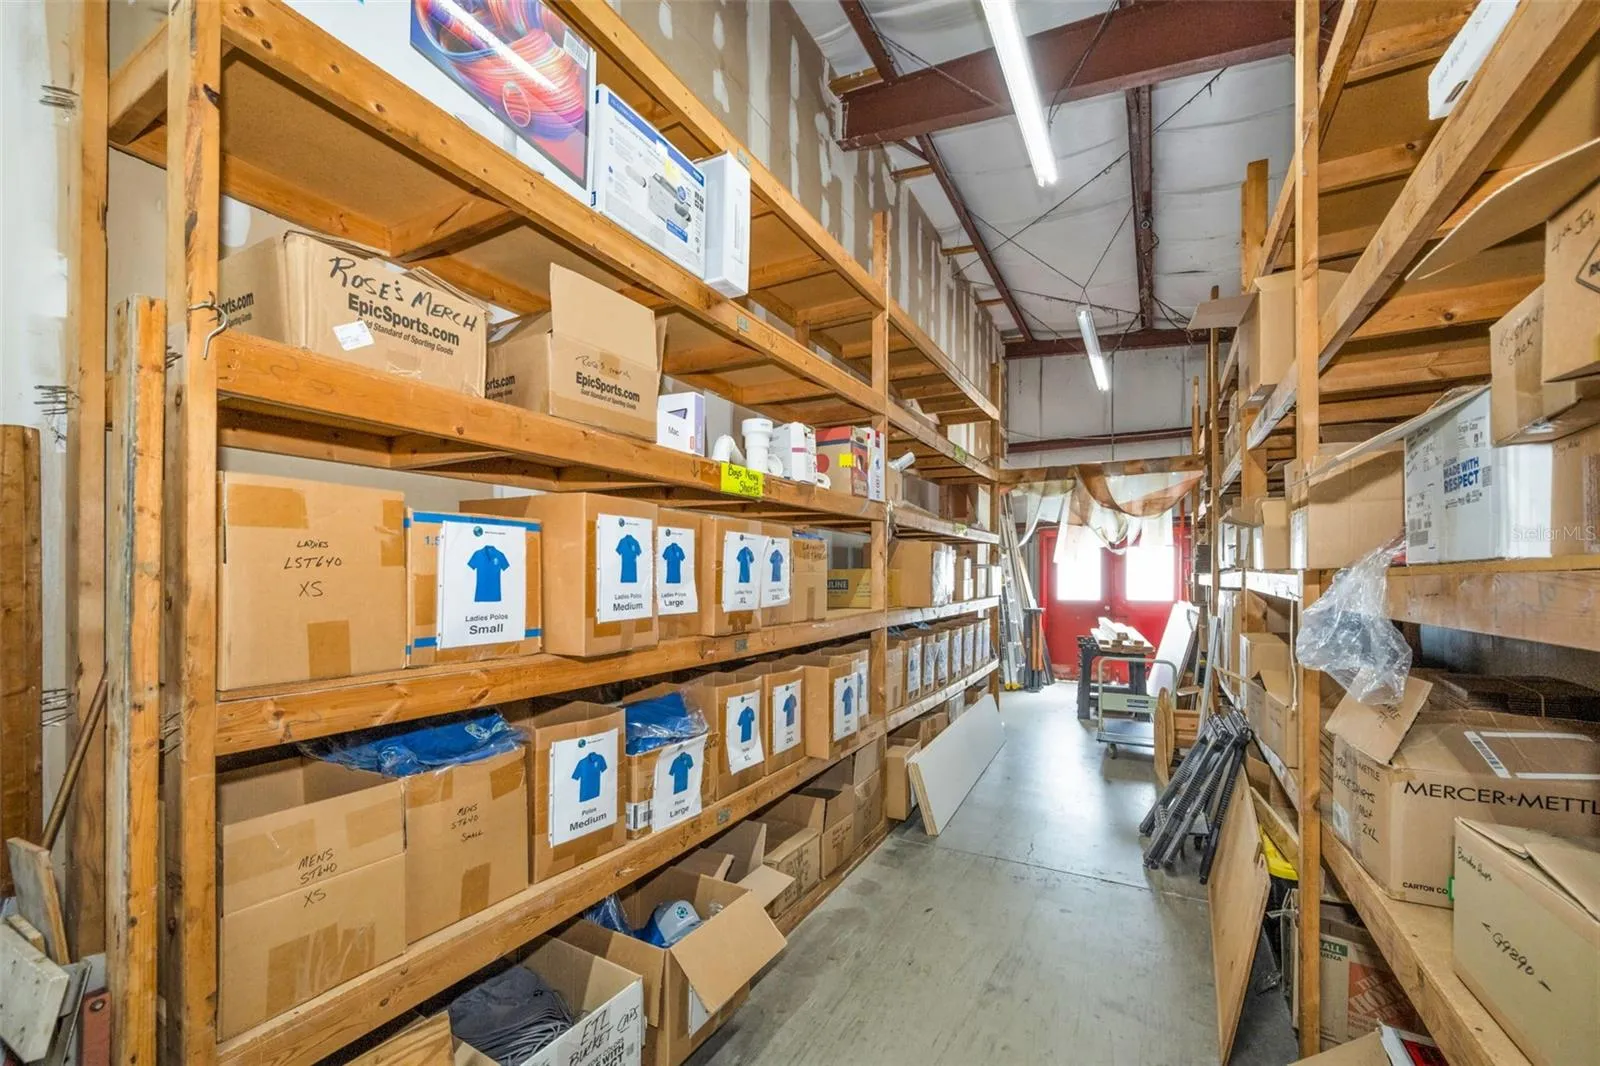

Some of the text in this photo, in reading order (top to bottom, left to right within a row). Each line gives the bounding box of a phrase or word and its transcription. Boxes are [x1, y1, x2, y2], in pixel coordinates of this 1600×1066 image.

[348, 292, 460, 346] EpicSports.com
[411, 291, 477, 332] MERCH
[373, 321, 403, 339] Standard
[403, 332, 411, 341] of
[411, 335, 436, 351] Sporting
[436, 343, 454, 356] Goods
[576, 371, 640, 402] EpicSports.com
[1461, 456, 1479, 472] WITH
[1443, 469, 1480, 494] RESPECT
[284, 555, 342, 570] LST640
[299, 580, 323, 597] XS
[613, 602, 643, 612] Medium
[664, 599, 684, 608] Large
[489, 613, 509, 621] Polos
[469, 623, 504, 635] Small
[669, 805, 690, 818] Large
[569, 811, 607, 832] Medium
[298, 848, 334, 871] MENS
[300, 862, 338, 885] ST640
[1402, 881, 1435, 894] CARTON
[304, 888, 327, 908] XS
